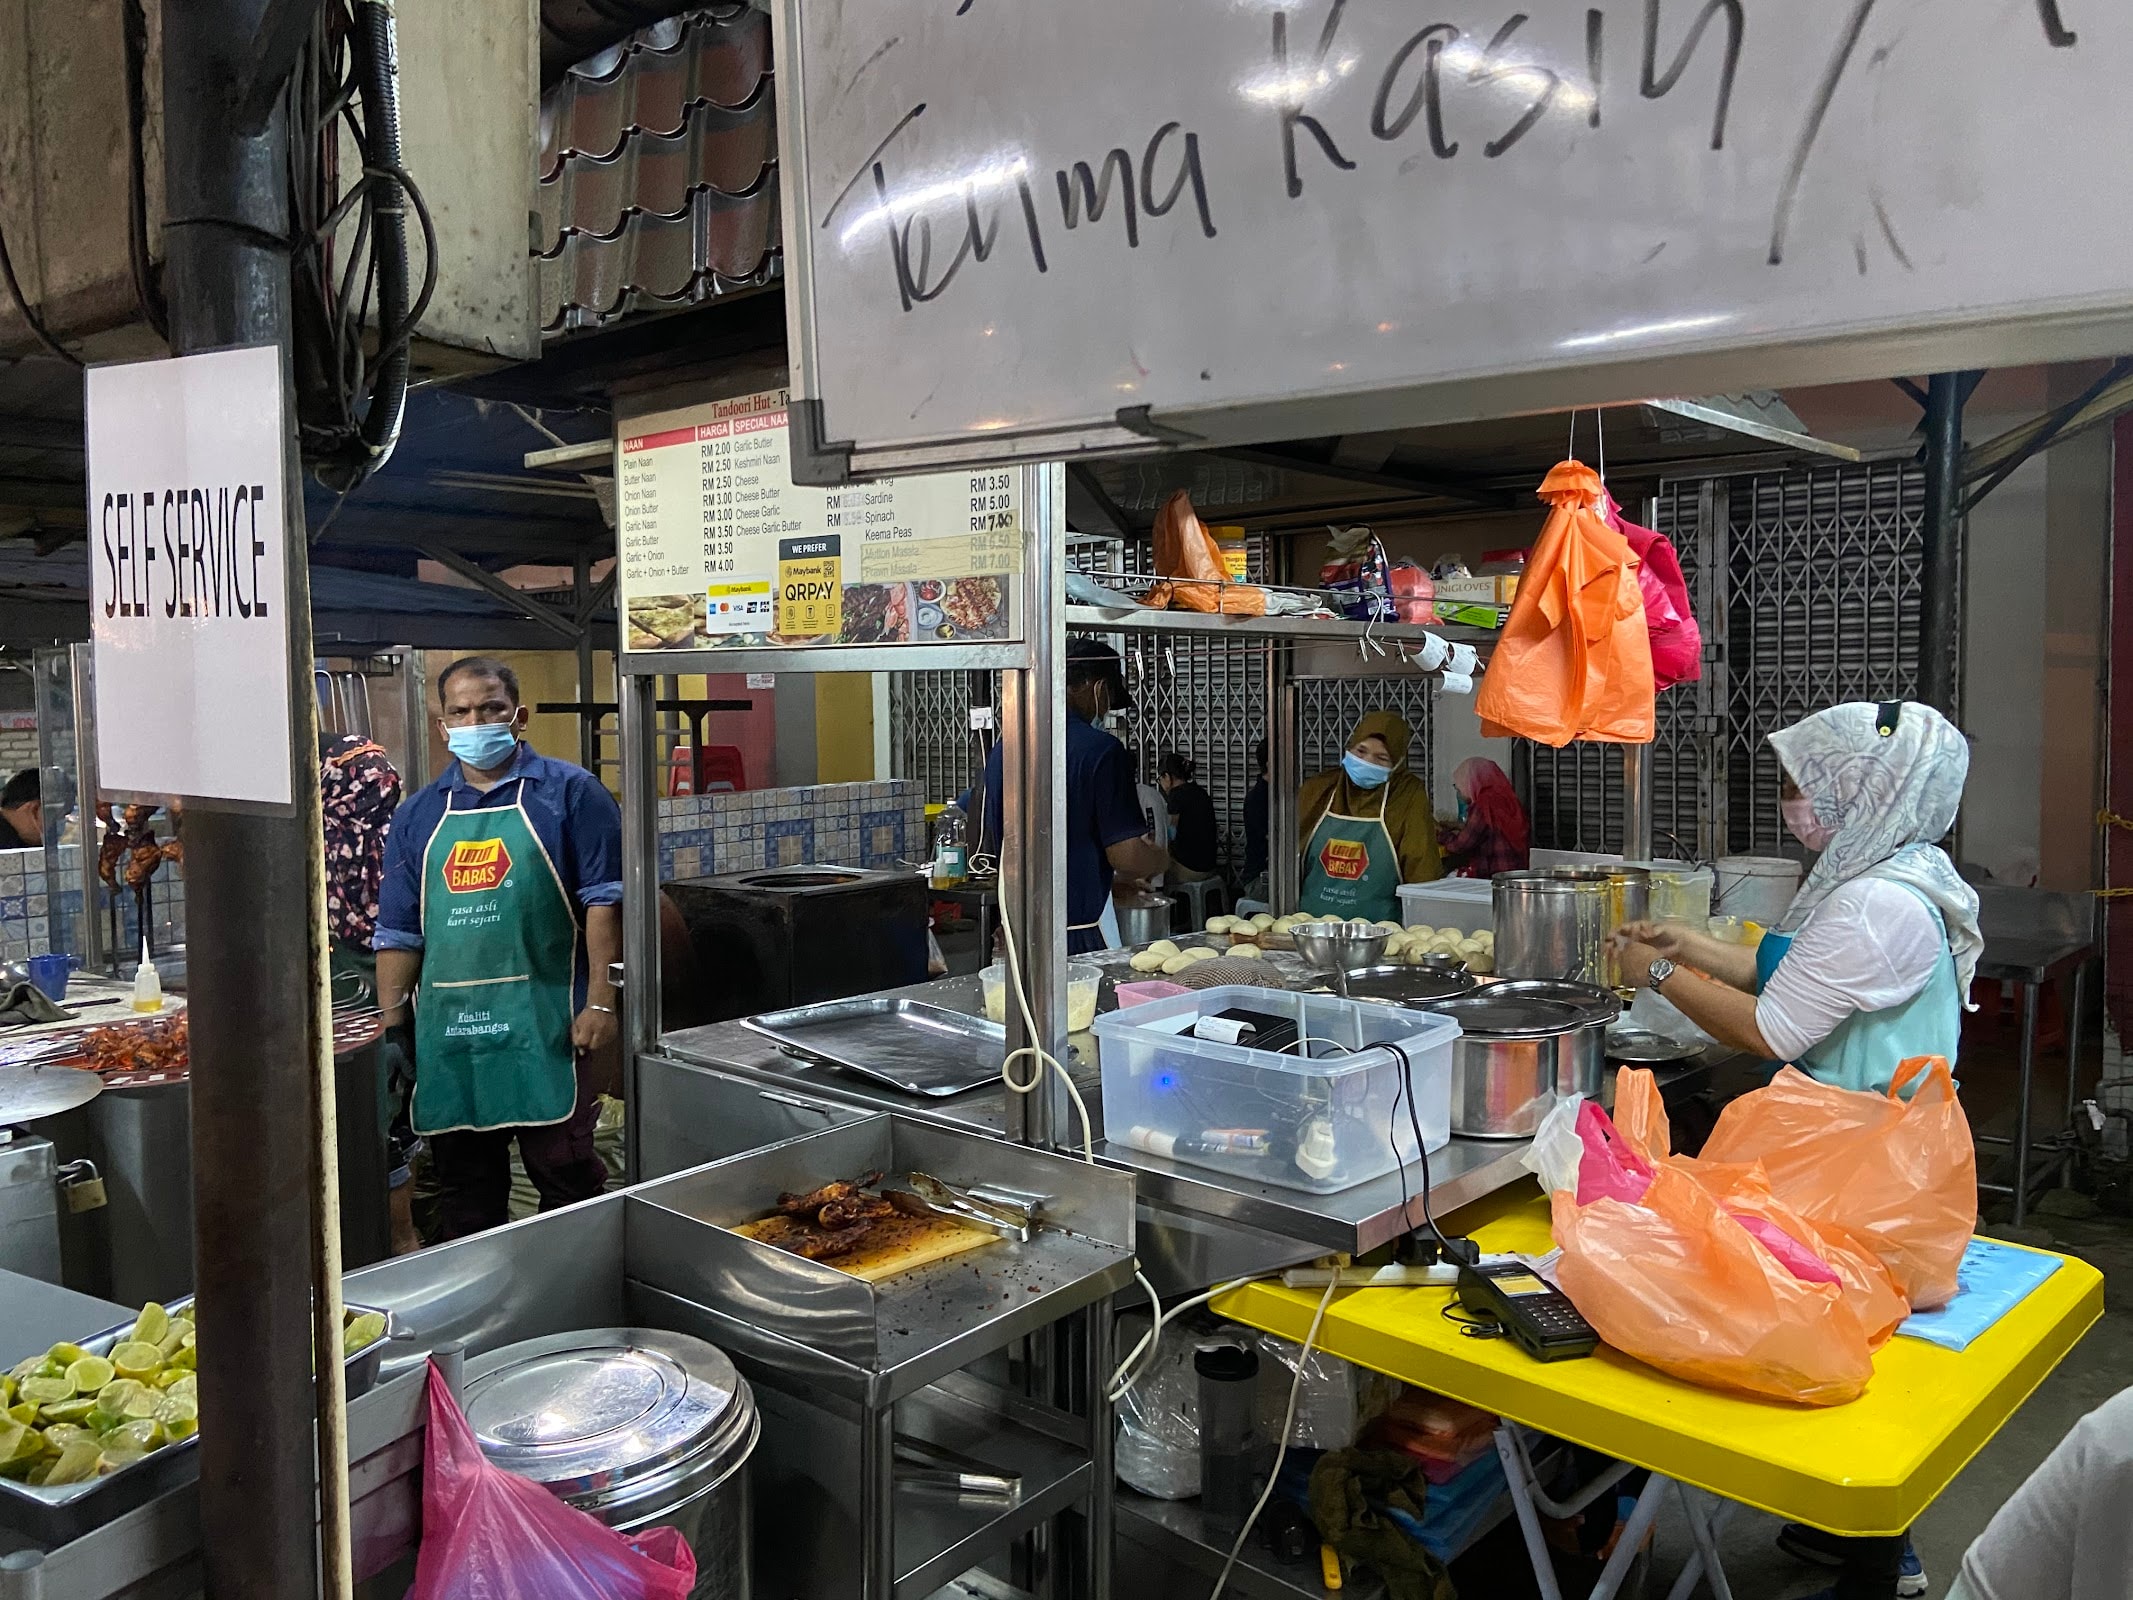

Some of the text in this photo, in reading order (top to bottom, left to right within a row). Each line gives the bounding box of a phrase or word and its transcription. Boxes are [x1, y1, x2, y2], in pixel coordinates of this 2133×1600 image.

[821, 103, 1217, 312] Terima
[712, 397, 751, 418] Tandoori
[754, 395, 770, 411] Hut
[700, 424, 728, 439] HARGA
[735, 416, 768, 433] SPECIAL
[624, 438, 644, 452] NAAN
[702, 442, 731, 458] RM 2.00
[734, 437, 773, 453] Garlic Butter
[624, 458, 653, 470] Plain Naan
[702, 459, 731, 474] RM 2.50
[763, 455, 780, 465] Naan
[624, 473, 656, 486] Butter Naan
[703, 476, 732, 491] RM 2.50
[735, 476, 758, 487] Cheese
[970, 474, 1009, 493] RM 3.50
[624, 489, 656, 501] Onion Naan
[703, 492, 732, 507] RM 3.00
[735, 489, 780, 502] Cheese Butter
[865, 492, 893, 505] Sardine
[827, 496, 840, 509] RM
[970, 494, 1009, 512] RM 5.00
[625, 504, 658, 517] Onion Butter
[704, 509, 732, 523] RM 3.00
[736, 506, 780, 520] Cheese Garlic
[865, 509, 894, 525] Spinach
[626, 520, 657, 532] Garlic Naan
[828, 514, 840, 527] RM
[970, 516, 986, 531] RM
[704, 525, 732, 539] RM 3.50
[736, 521, 801, 536] Cheese Garlic Butter
[866, 526, 912, 541] Keema Peas
[626, 536, 659, 548] Garlic Butter
[704, 542, 733, 556] RM 3.50
[792, 543, 827, 554] WE PREFER
[103, 484, 268, 620] SELF SERVICE
[626, 553, 642, 562] Garlic
[648, 551, 664, 560] Onion
[626, 569, 642, 579] Garlic
[648, 568, 665, 578] Onion
[672, 566, 689, 576] Butter
[705, 560, 734, 572] RM 4.00
[793, 566, 821, 576] Maybank
[786, 581, 834, 601] QRPAY
[476, 900, 497, 912] asli
[447, 912, 501, 928] kari sejati
